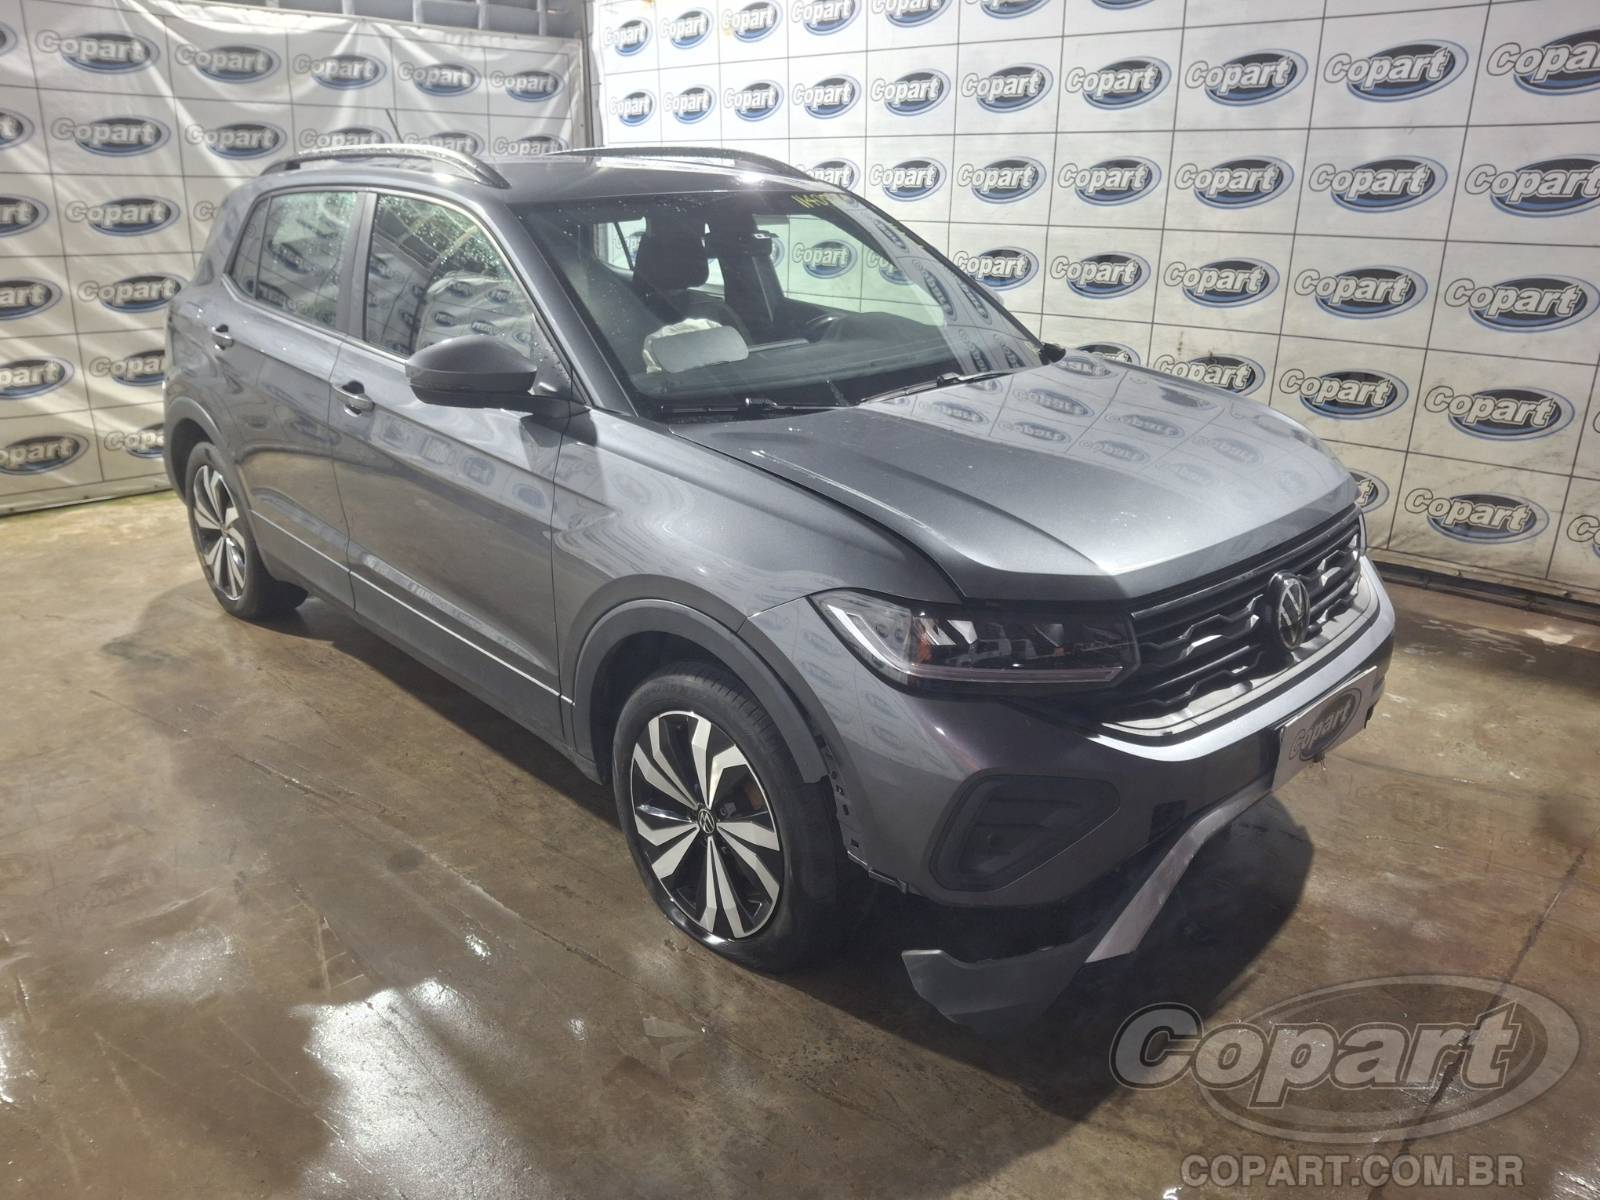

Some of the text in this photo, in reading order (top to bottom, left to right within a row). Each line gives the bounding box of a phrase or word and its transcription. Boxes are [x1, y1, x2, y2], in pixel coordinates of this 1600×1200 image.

[722, 6, 776, 35] Copart
[791, 0, 853, 27] Copart
[604, 23, 646, 47] Copart
[660, 15, 708, 43] Copart
[36, 29, 149, 63] Copart
[176, 44, 270, 73] Copart
[292, 54, 374, 78] Copart
[399, 62, 471, 86] Copart
[1184, 56, 1293, 95] Copart
[1324, 46, 1451, 91] Copart
[1487, 41, 1600, 83] Copa
[490, 71, 556, 93] Copart
[792, 82, 853, 111] Copart
[871, 76, 942, 108] Copart
[961, 66, 1042, 103] Copart
[1065, 64, 1158, 100] Copart
[610, 96, 652, 121] Copart
[663, 90, 709, 118] Copart
[723, 86, 777, 113] Copart
[51, 118, 155, 147] Copart
[185, 124, 274, 149] Copart
[869, 163, 939, 189] Copart
[957, 162, 1036, 193] Copart
[1058, 162, 1148, 196] Copart
[1174, 162, 1281, 198] Copart
[1309, 163, 1435, 200] Copart
[1465, 163, 1600, 205] Copart
[65, 201, 169, 227] Copart
[791, 242, 849, 271] Copart
[952, 251, 1028, 279] Copart
[1050, 255, 1139, 286] Copart
[77, 279, 175, 307] Copart
[1164, 262, 1266, 296] Copart
[1294, 269, 1411, 308] Copart
[0, 283, 46, 307] art
[1444, 278, 1582, 319] Copart
[90, 356, 165, 382] Copa
[1154, 354, 1252, 389] Copart
[1279, 368, 1394, 409] Copart
[1425, 386, 1558, 428] Copart
[1404, 488, 1532, 532] Copart
[1289, 701, 1351, 761] Copart
